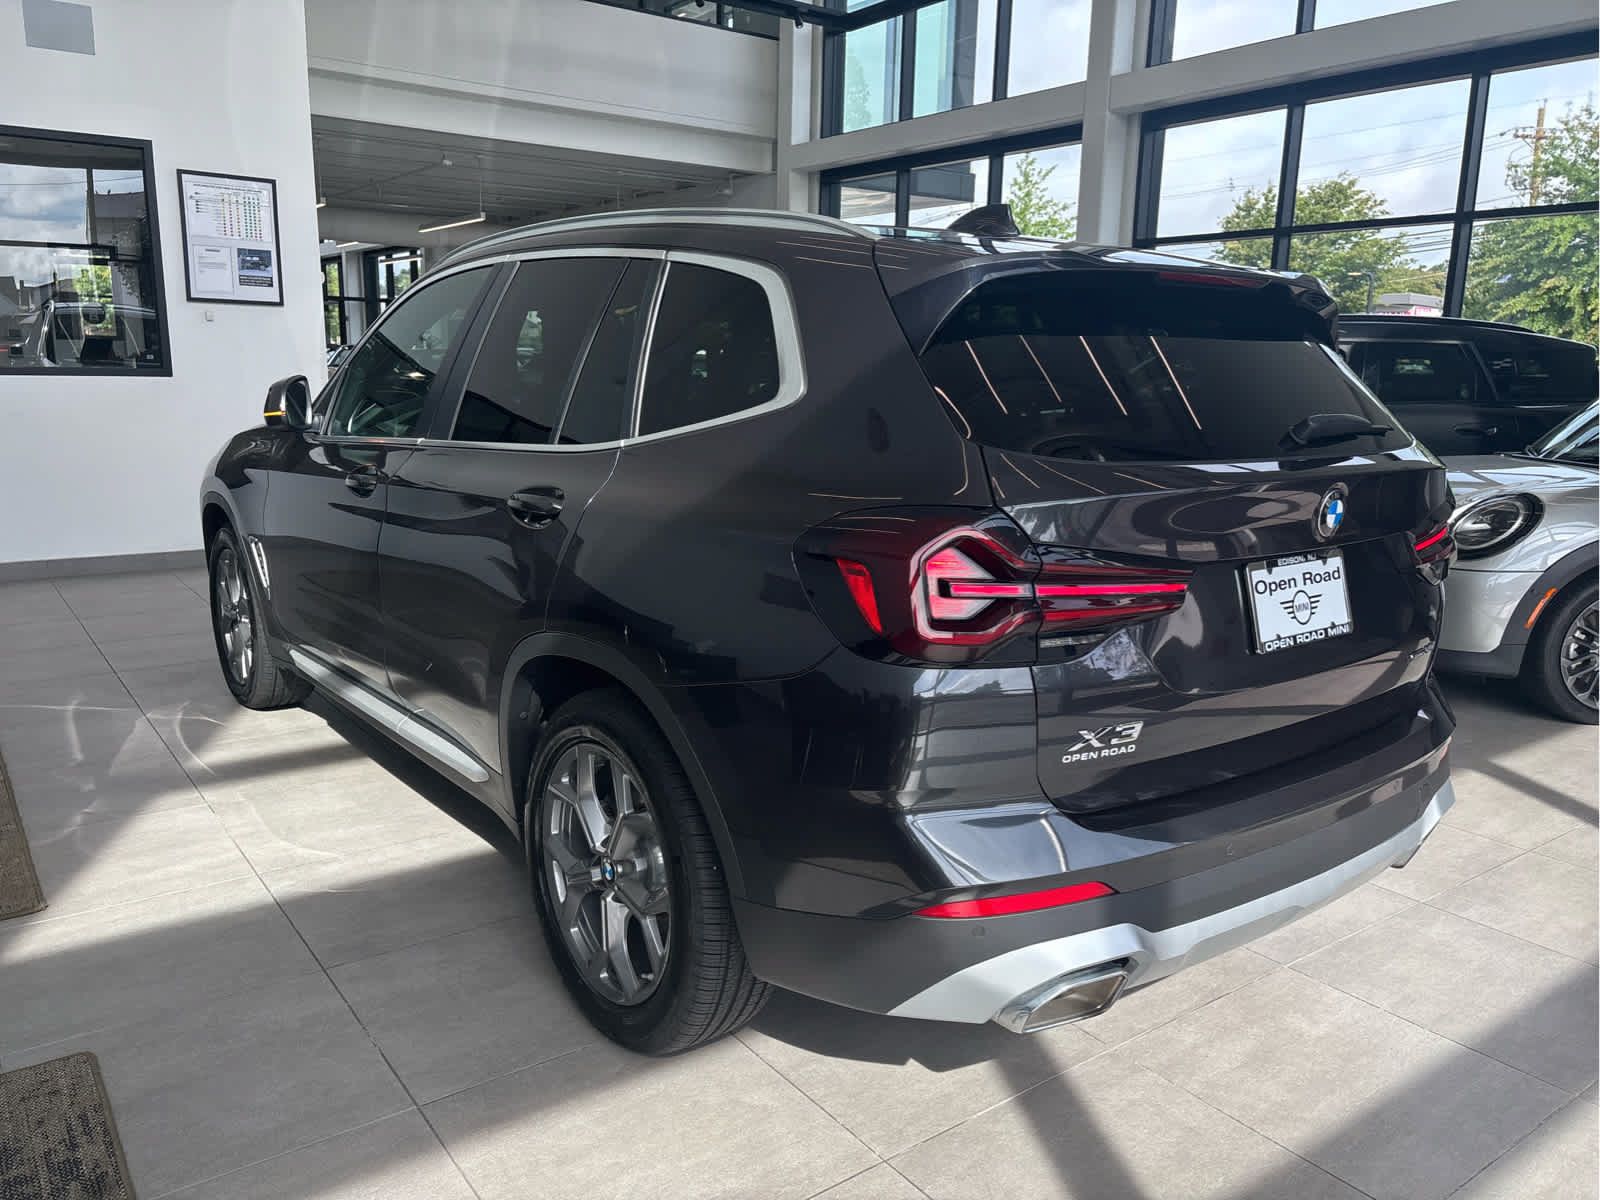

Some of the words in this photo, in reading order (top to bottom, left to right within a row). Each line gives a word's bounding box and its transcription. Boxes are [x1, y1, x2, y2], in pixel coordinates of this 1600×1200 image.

[1254, 577, 1297, 596] Open
[1302, 566, 1341, 586] Road
[1264, 636, 1295, 652] OPEN
[1296, 629, 1326, 644] ROAD
[1327, 623, 1350, 637] MINI
[1065, 720, 1144, 752] X3
[1062, 750, 1098, 763] OPEN
[1100, 744, 1136, 758] ROAD
